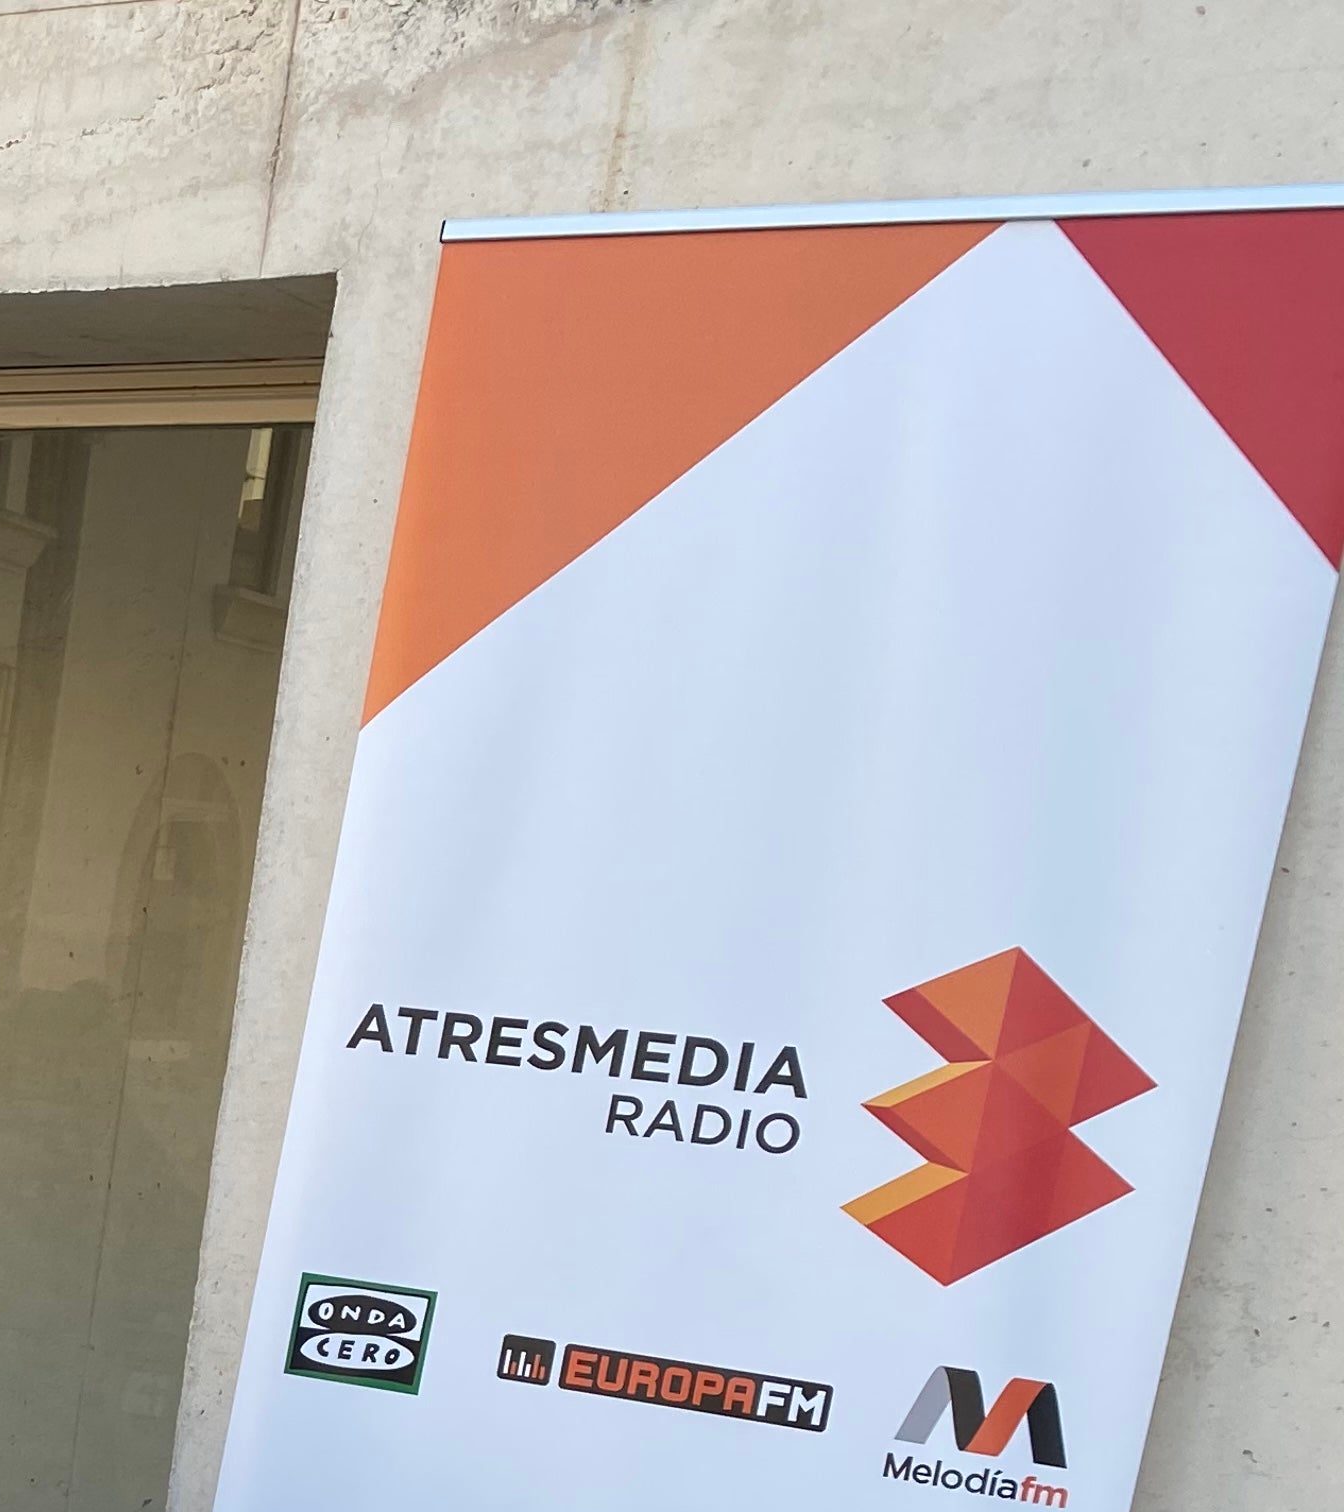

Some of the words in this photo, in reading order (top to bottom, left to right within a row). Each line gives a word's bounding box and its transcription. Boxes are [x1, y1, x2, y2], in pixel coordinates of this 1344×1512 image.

[346, 1002, 808, 1099] ATRESMEDIA
[606, 1094, 800, 1154] RADIO
[318, 1302, 405, 1329] ONDA
[317, 1337, 400, 1365] CERO
[883, 1452, 1069, 1508] Melodíafm
